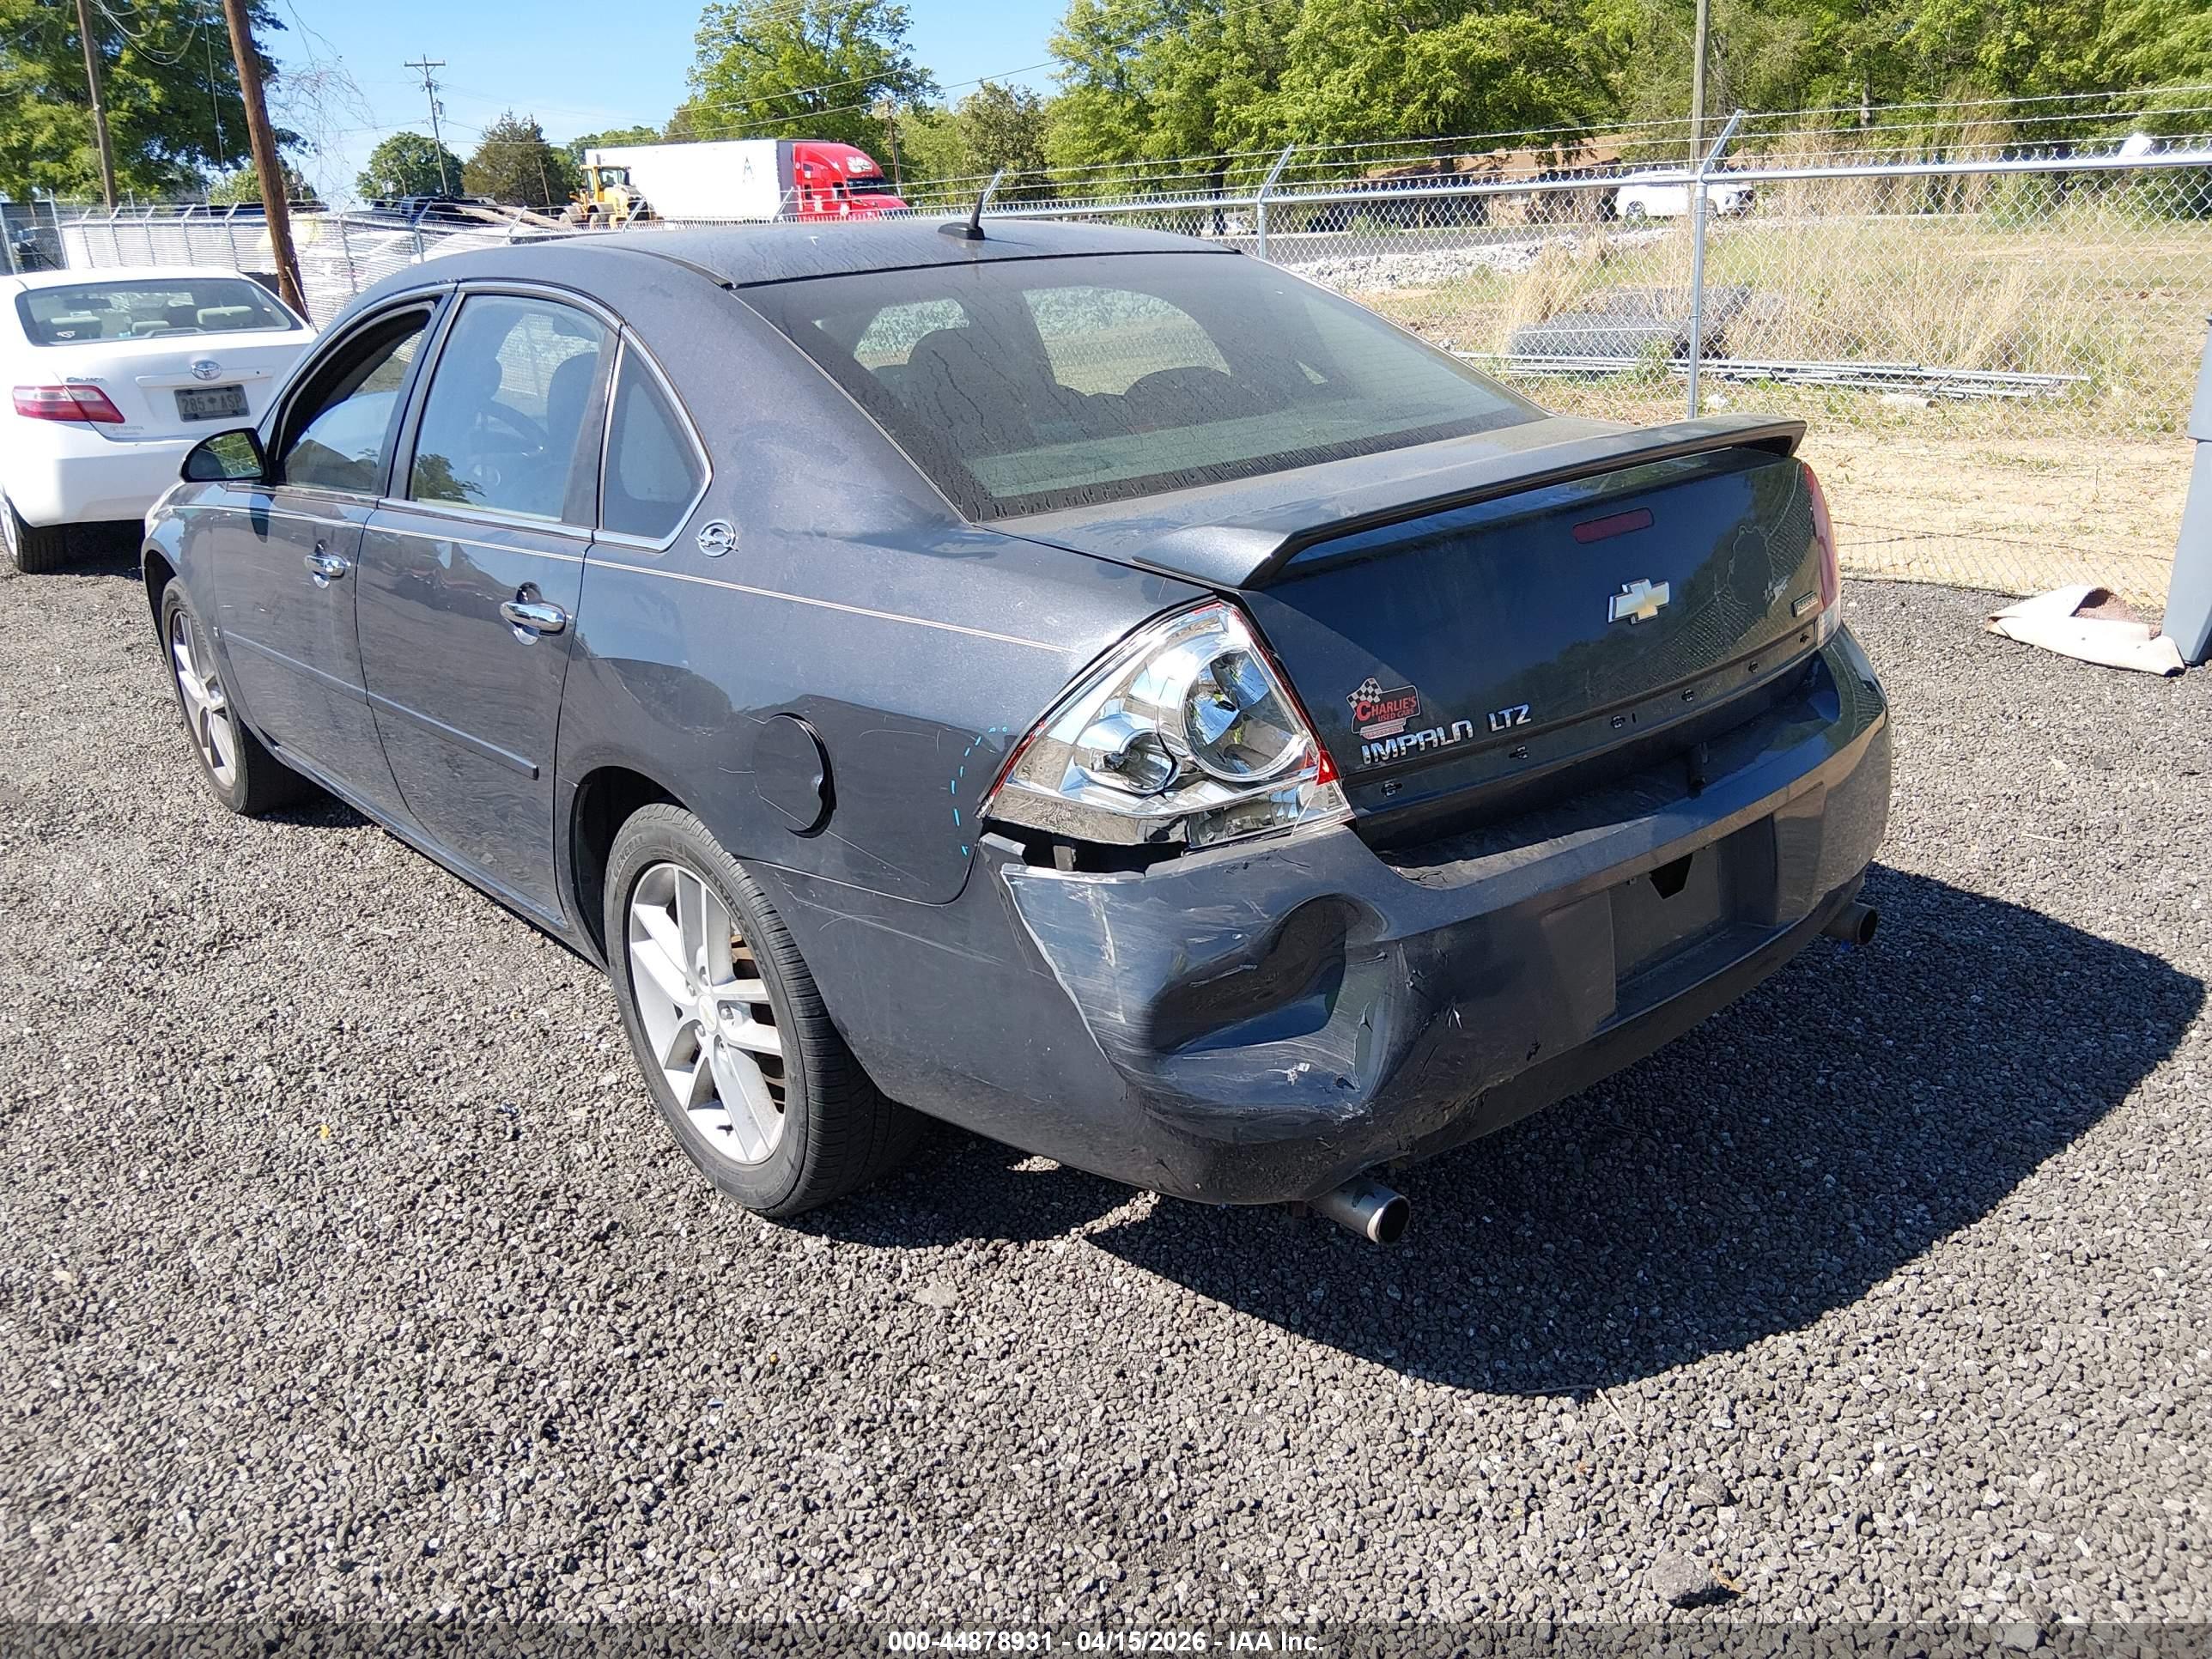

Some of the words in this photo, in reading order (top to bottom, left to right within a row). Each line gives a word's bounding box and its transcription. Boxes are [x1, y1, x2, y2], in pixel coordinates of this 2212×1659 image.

[181, 397, 206, 412] 285
[221, 393, 241, 410] ASP
[1356, 695, 1417, 721] CHARLIE'S
[1378, 713, 1395, 723] USED
[1396, 708, 1414, 720] CARS
[1361, 720, 1474, 764] IMPALA
[1488, 704, 1532, 732] LTZ
[613, 834, 646, 878] GENERAL
